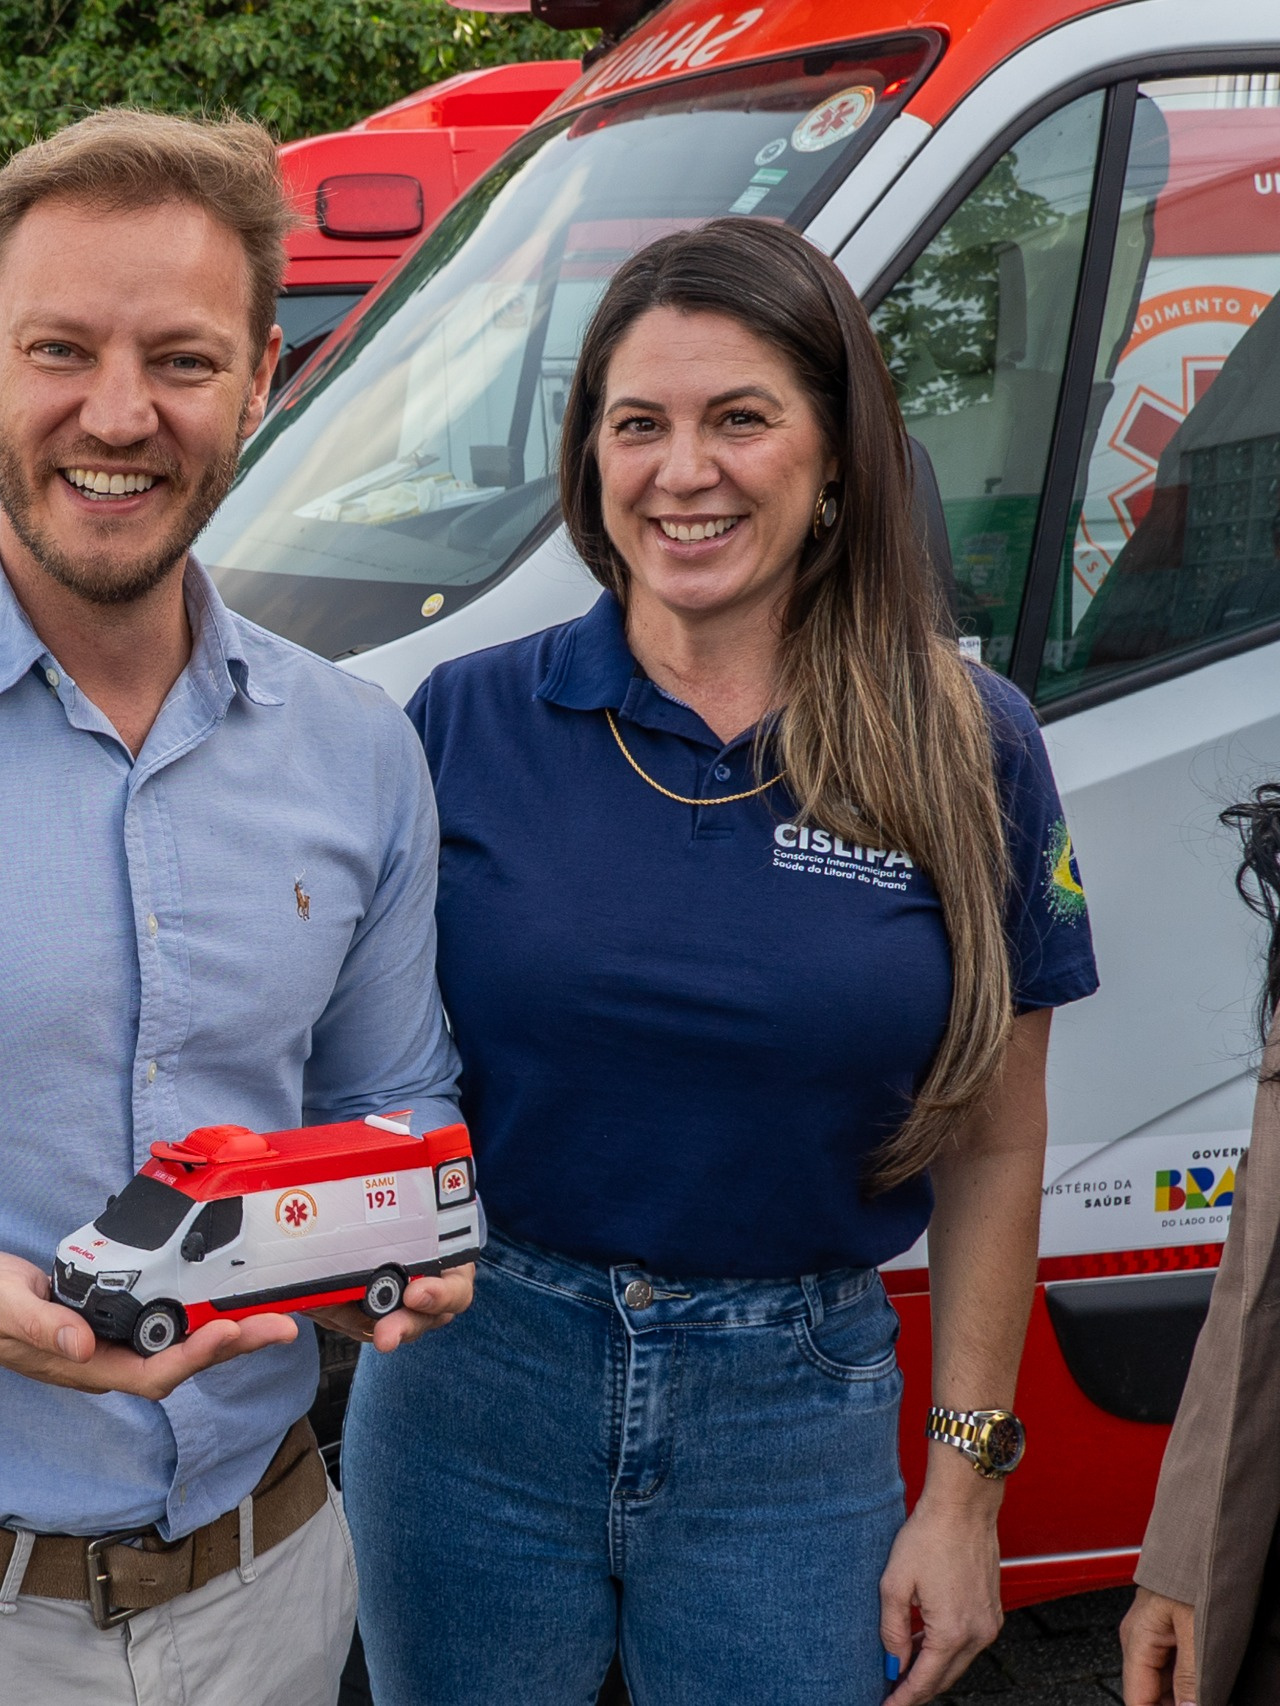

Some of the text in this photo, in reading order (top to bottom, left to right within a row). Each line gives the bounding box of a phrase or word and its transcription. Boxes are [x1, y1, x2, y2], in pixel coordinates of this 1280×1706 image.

[773, 849, 912, 880] Consórcio Intermunicipal de
[772, 858, 907, 891] Saúde do Litoral do Paraná
[365, 1176, 395, 1189] SAMU
[1114, 1180, 1131, 1190] DA
[366, 1190, 396, 1209] 192
[1084, 1195, 1131, 1208] SAÚDE
[1161, 1219, 1176, 1228] DO
[1179, 1217, 1206, 1226] LADO
[1209, 1215, 1223, 1225] DO
